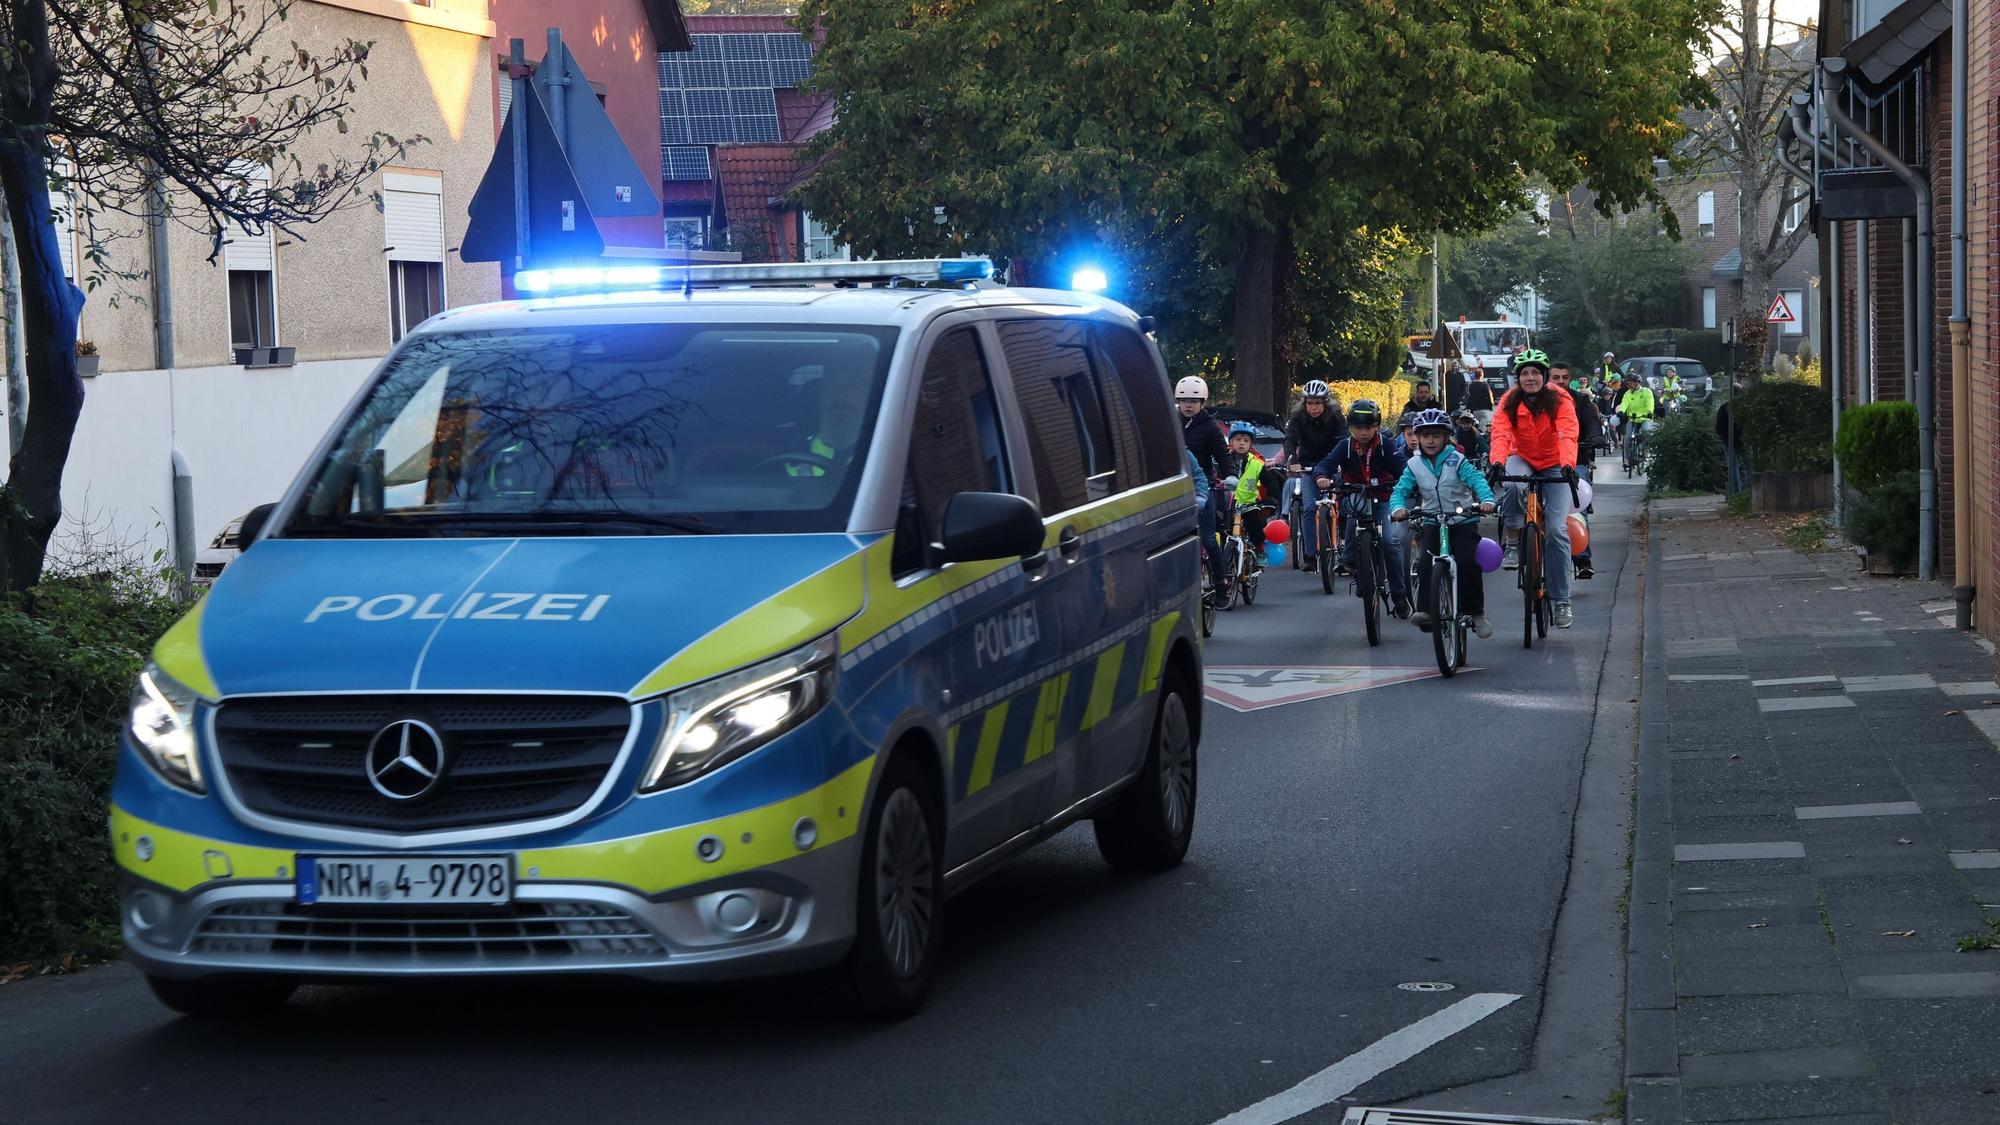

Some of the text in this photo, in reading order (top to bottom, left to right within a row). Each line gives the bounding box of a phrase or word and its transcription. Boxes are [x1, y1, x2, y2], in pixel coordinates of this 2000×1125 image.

[303, 592, 611, 623] POLIZEI
[974, 599, 1040, 669] POLIZEI
[318, 862, 504, 898] NRW 4-9798
